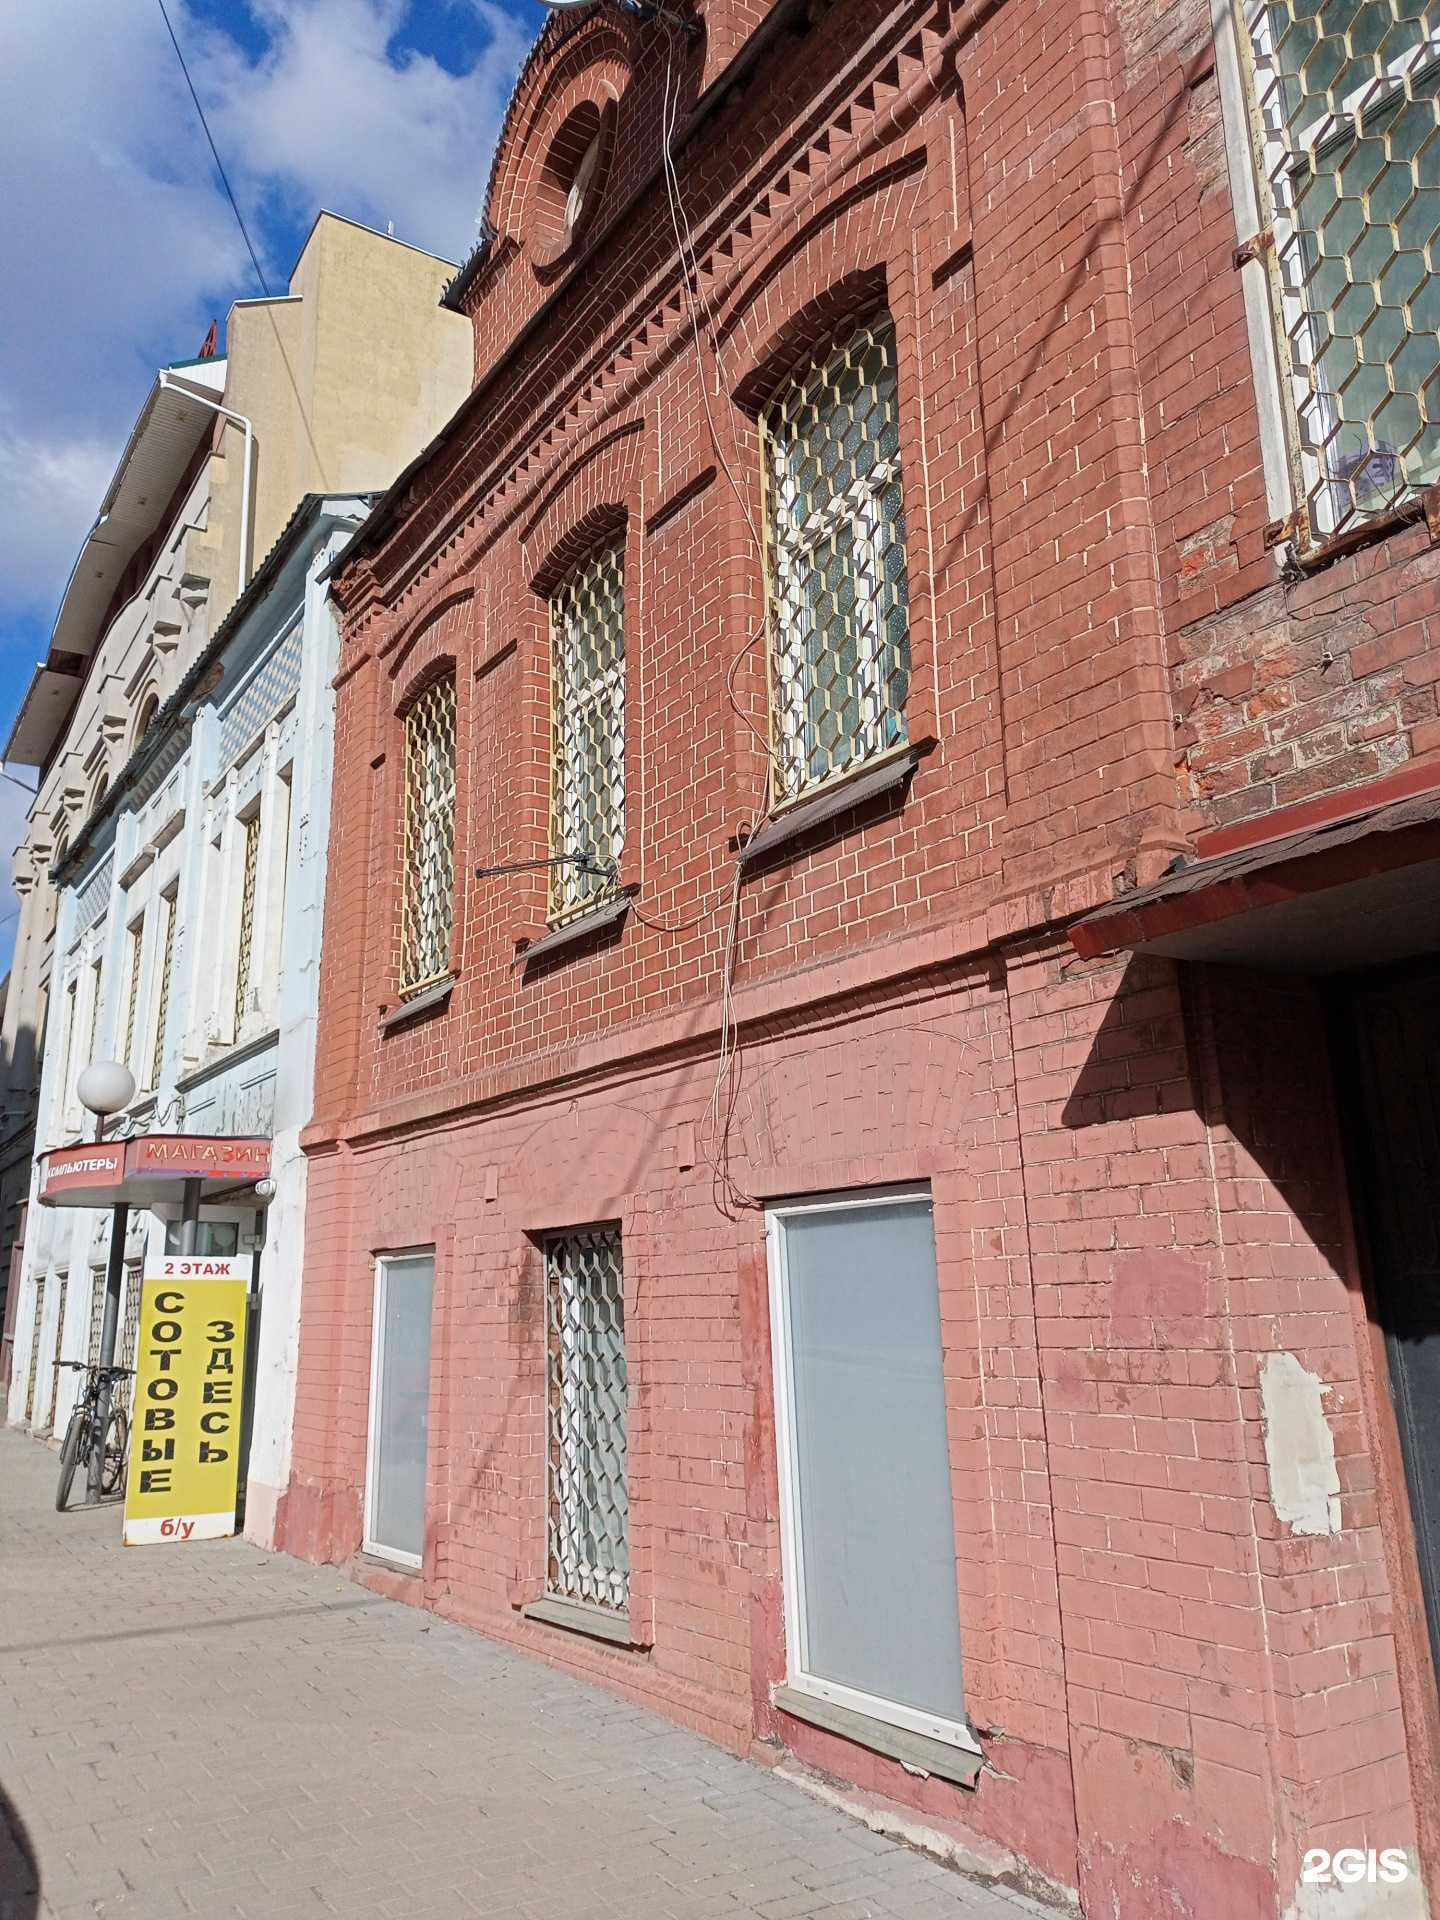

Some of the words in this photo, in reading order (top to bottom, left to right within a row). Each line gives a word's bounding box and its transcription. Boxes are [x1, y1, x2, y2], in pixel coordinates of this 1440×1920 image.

[147, 1143, 271, 1162] МАГАЗИН
[47, 1157, 118, 1178] КОМПЬЮТЕРЫ
[164, 1262, 174, 1275] 2
[180, 1263, 231, 1275] ЭТАЖ
[139, 1291, 185, 1494] СОТОВЫЕ
[199, 1320, 235, 1463] ЗДЕСЬ
[160, 1518, 195, 1539] б/у
